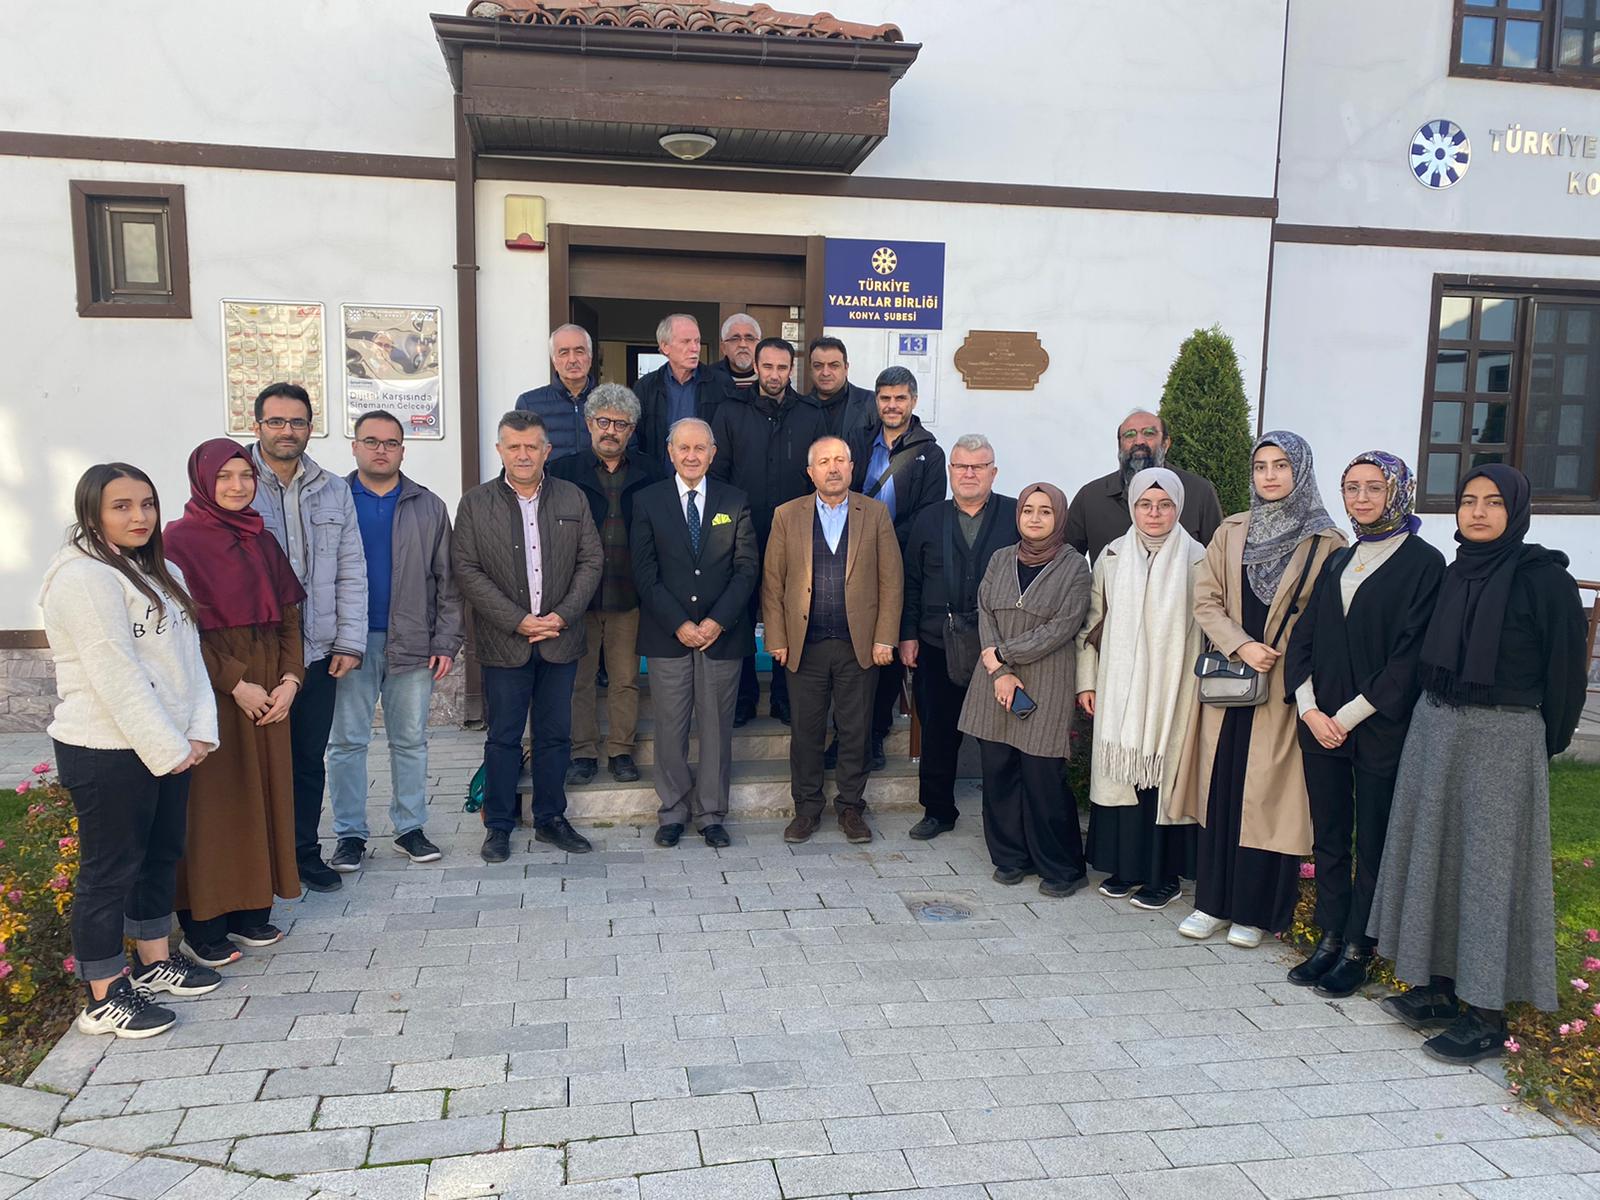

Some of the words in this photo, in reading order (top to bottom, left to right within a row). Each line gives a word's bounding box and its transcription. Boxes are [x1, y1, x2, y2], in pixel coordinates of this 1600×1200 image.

[1489, 123, 1597, 159] TÜRKİYE
[858, 278, 910, 293] TÜRKİYE
[829, 294, 892, 308] YAZARLAR
[894, 294, 938, 309] BİRLİĞİ
[849, 311, 880, 320] KONYA
[884, 311, 917, 322] ŞUBESİ
[903, 337, 924, 352] 13
[382, 392, 433, 402] Karşısında
